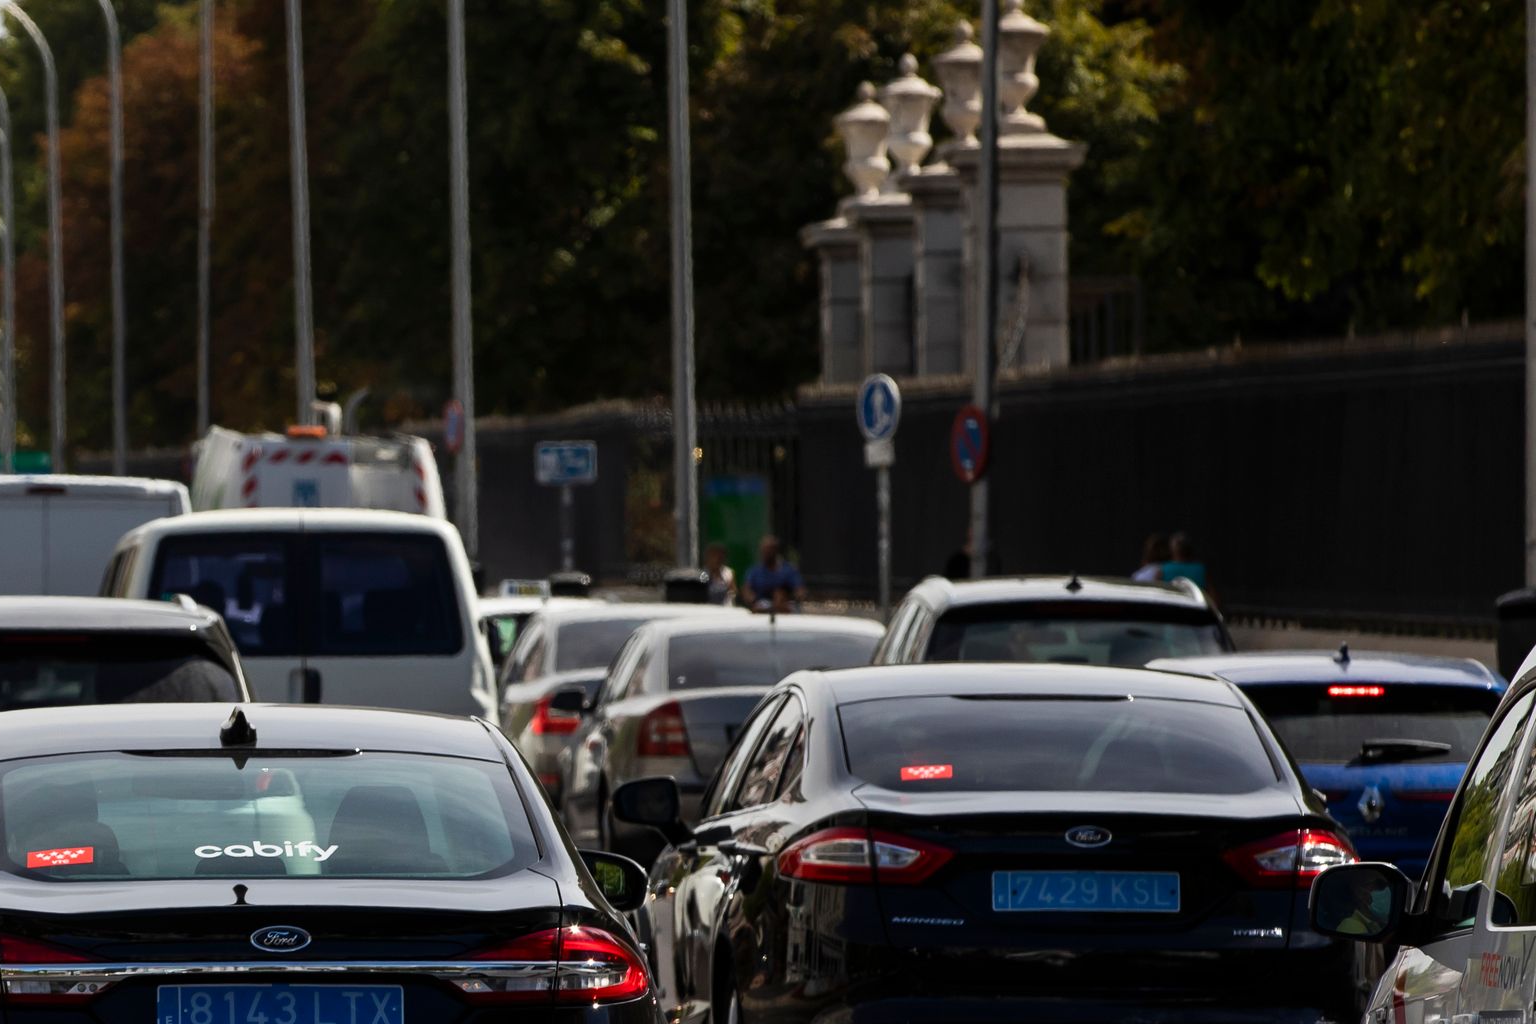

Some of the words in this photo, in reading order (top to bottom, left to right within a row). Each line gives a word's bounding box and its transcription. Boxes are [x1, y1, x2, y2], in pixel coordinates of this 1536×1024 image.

[194, 840, 339, 862] cabify
[1016, 876, 1099, 904] 7429
[1111, 876, 1171, 906] KSL
[263, 930, 298, 946] Ford
